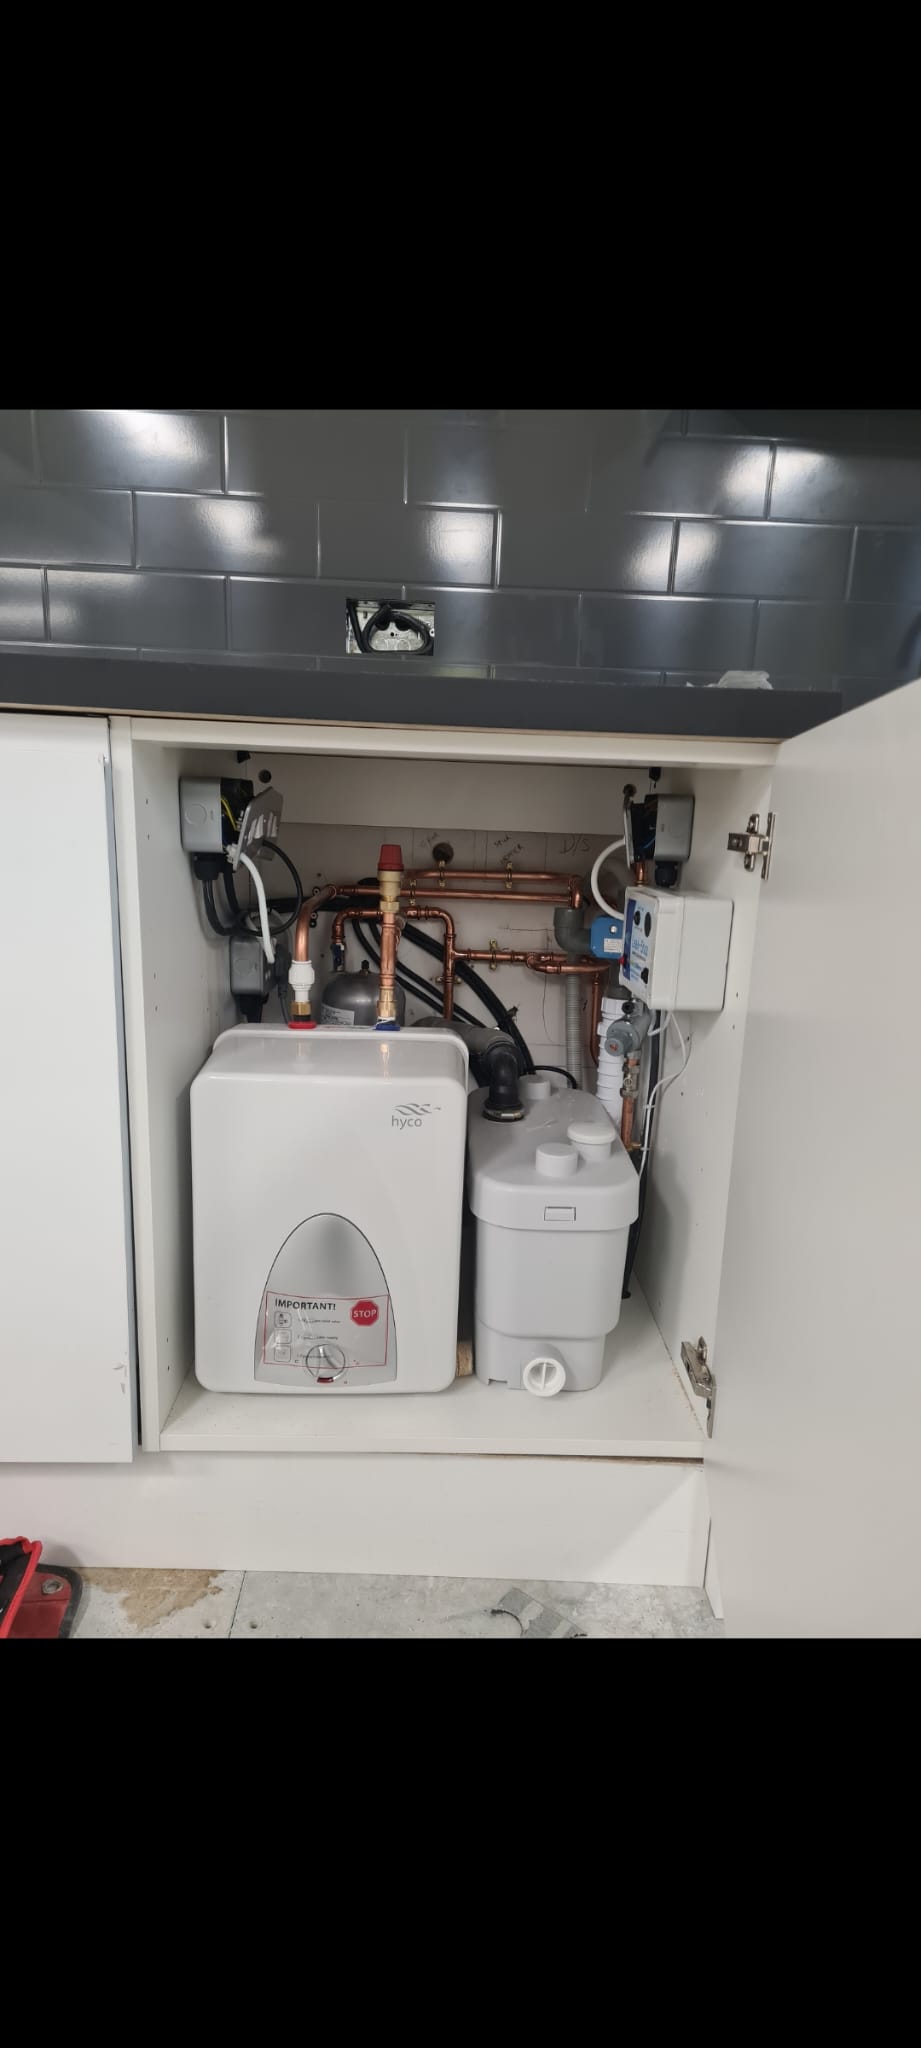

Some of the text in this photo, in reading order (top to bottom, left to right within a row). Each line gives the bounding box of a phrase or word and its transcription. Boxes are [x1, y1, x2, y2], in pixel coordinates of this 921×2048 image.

[391, 1114, 423, 1131] hyco
[274, 1298, 336, 1311] IMPORTANT!
[352, 1308, 377, 1319] STOP
